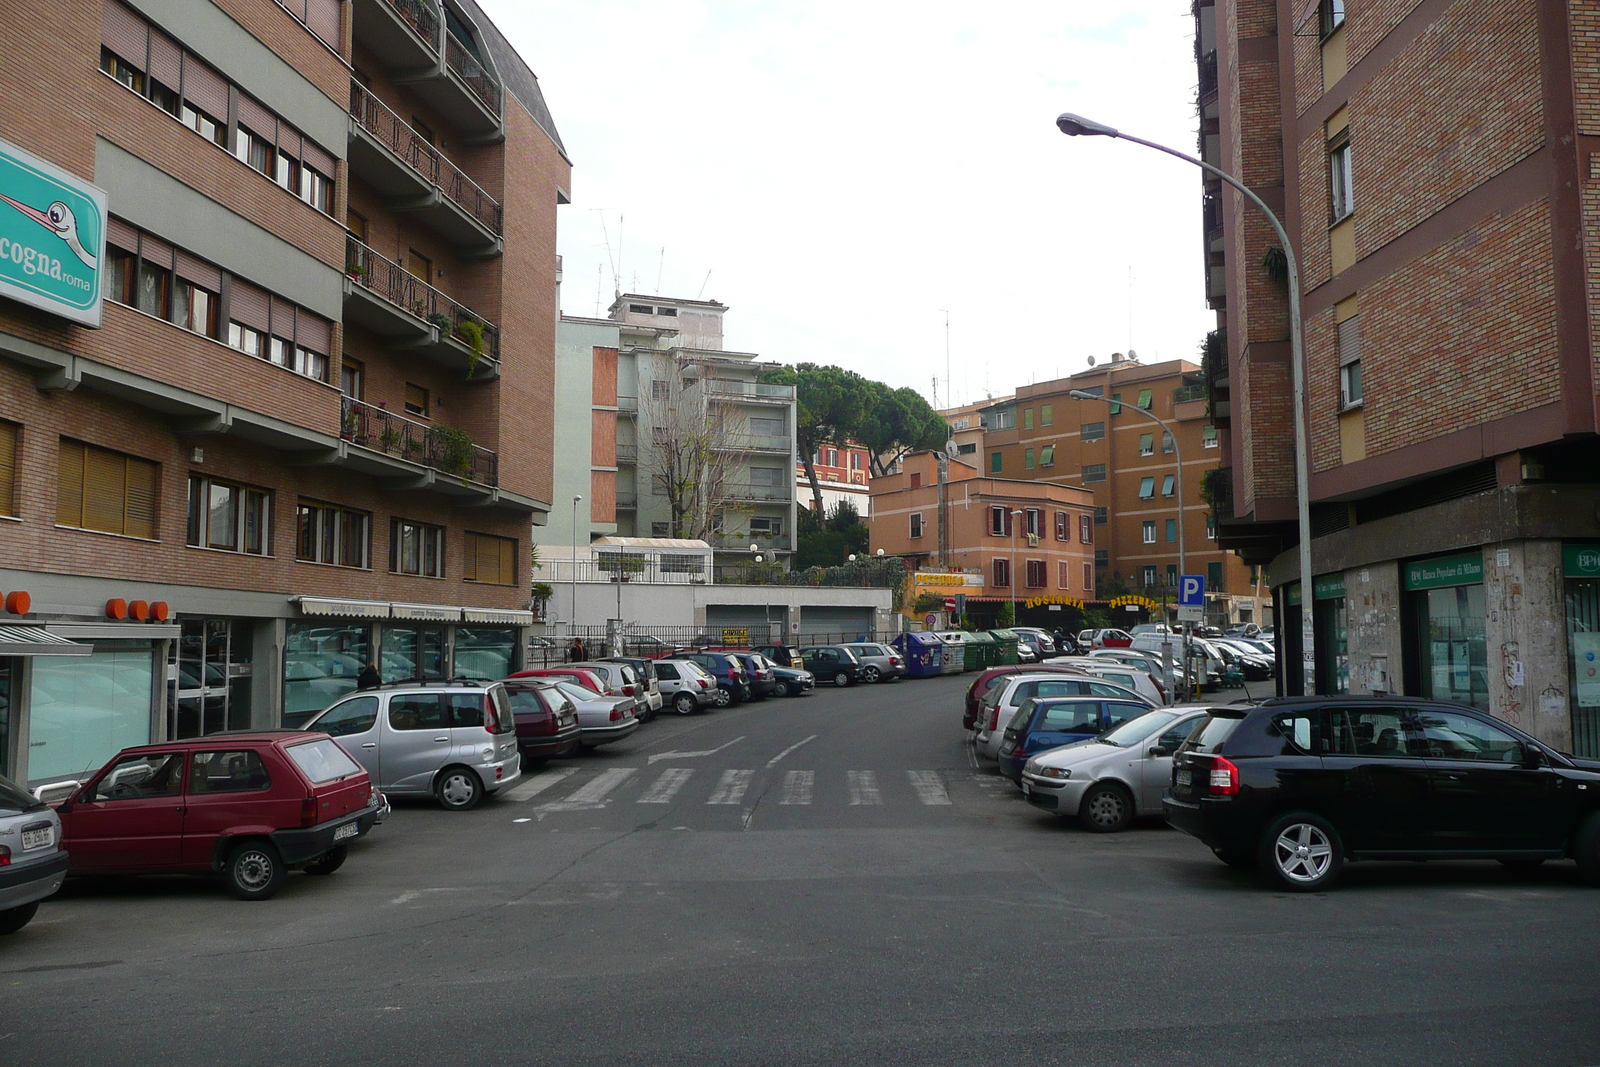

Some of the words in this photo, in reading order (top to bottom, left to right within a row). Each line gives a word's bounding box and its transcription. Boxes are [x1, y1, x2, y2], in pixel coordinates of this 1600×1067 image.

[62, 272, 91, 292] roma
[1422, 569, 1436, 580] Banca
[1436, 566, 1456, 580] Popolare
[1456, 564, 1463, 575] di
[1463, 563, 1481, 574] Milano
[916, 574, 966, 586] PIZZERIA
[1183, 578, 1199, 603] P
[1025, 594, 1086, 610] HOSTARIA
[1110, 594, 1157, 610] PIZZERIA
